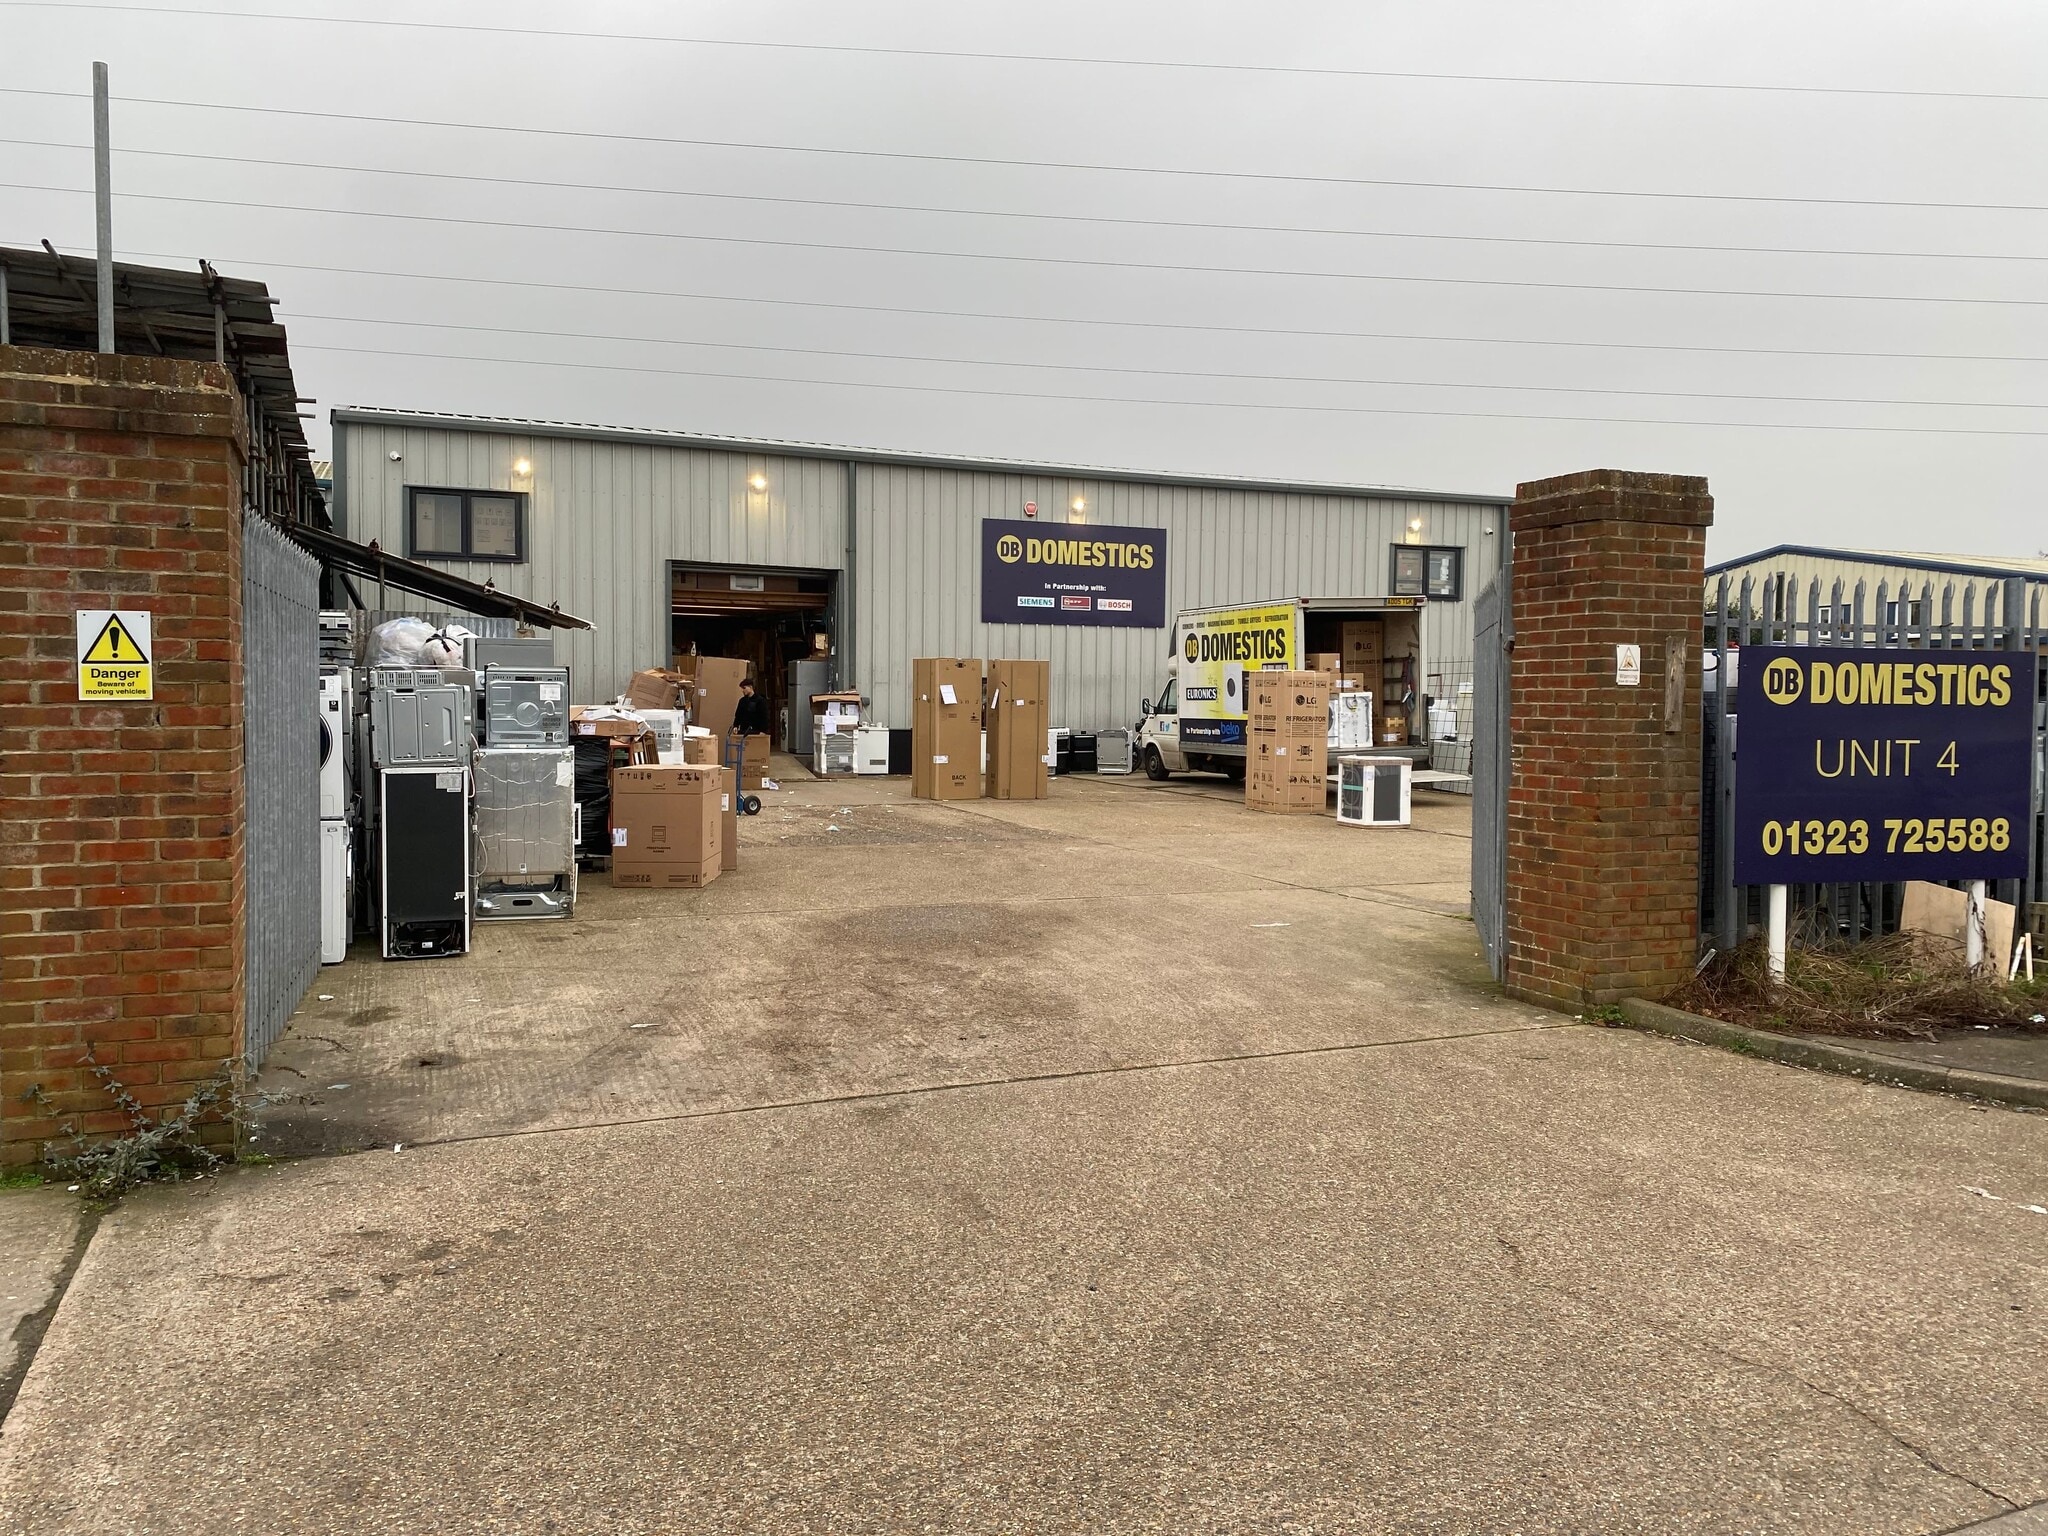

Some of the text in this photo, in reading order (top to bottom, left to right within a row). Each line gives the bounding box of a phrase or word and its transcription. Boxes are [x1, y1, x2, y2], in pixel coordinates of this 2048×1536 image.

[1000, 538, 1154, 569] DB DOMESTICS
[1053, 583, 1089, 592] Partnership
[1019, 598, 1053, 606] SIEMENS
[1108, 601, 1131, 609] BOSCH
[1187, 628, 1286, 662] DB DOMESTICS
[91, 668, 141, 680] Danger
[1769, 662, 2012, 706] DB DOMESTICS
[1187, 689, 1217, 699] EURONICS
[1190, 728, 1211, 736] Partnership
[1221, 722, 1240, 735] beko
[1815, 740, 1959, 778] UNIT 4
[1762, 817, 2010, 855] 01323 725588
